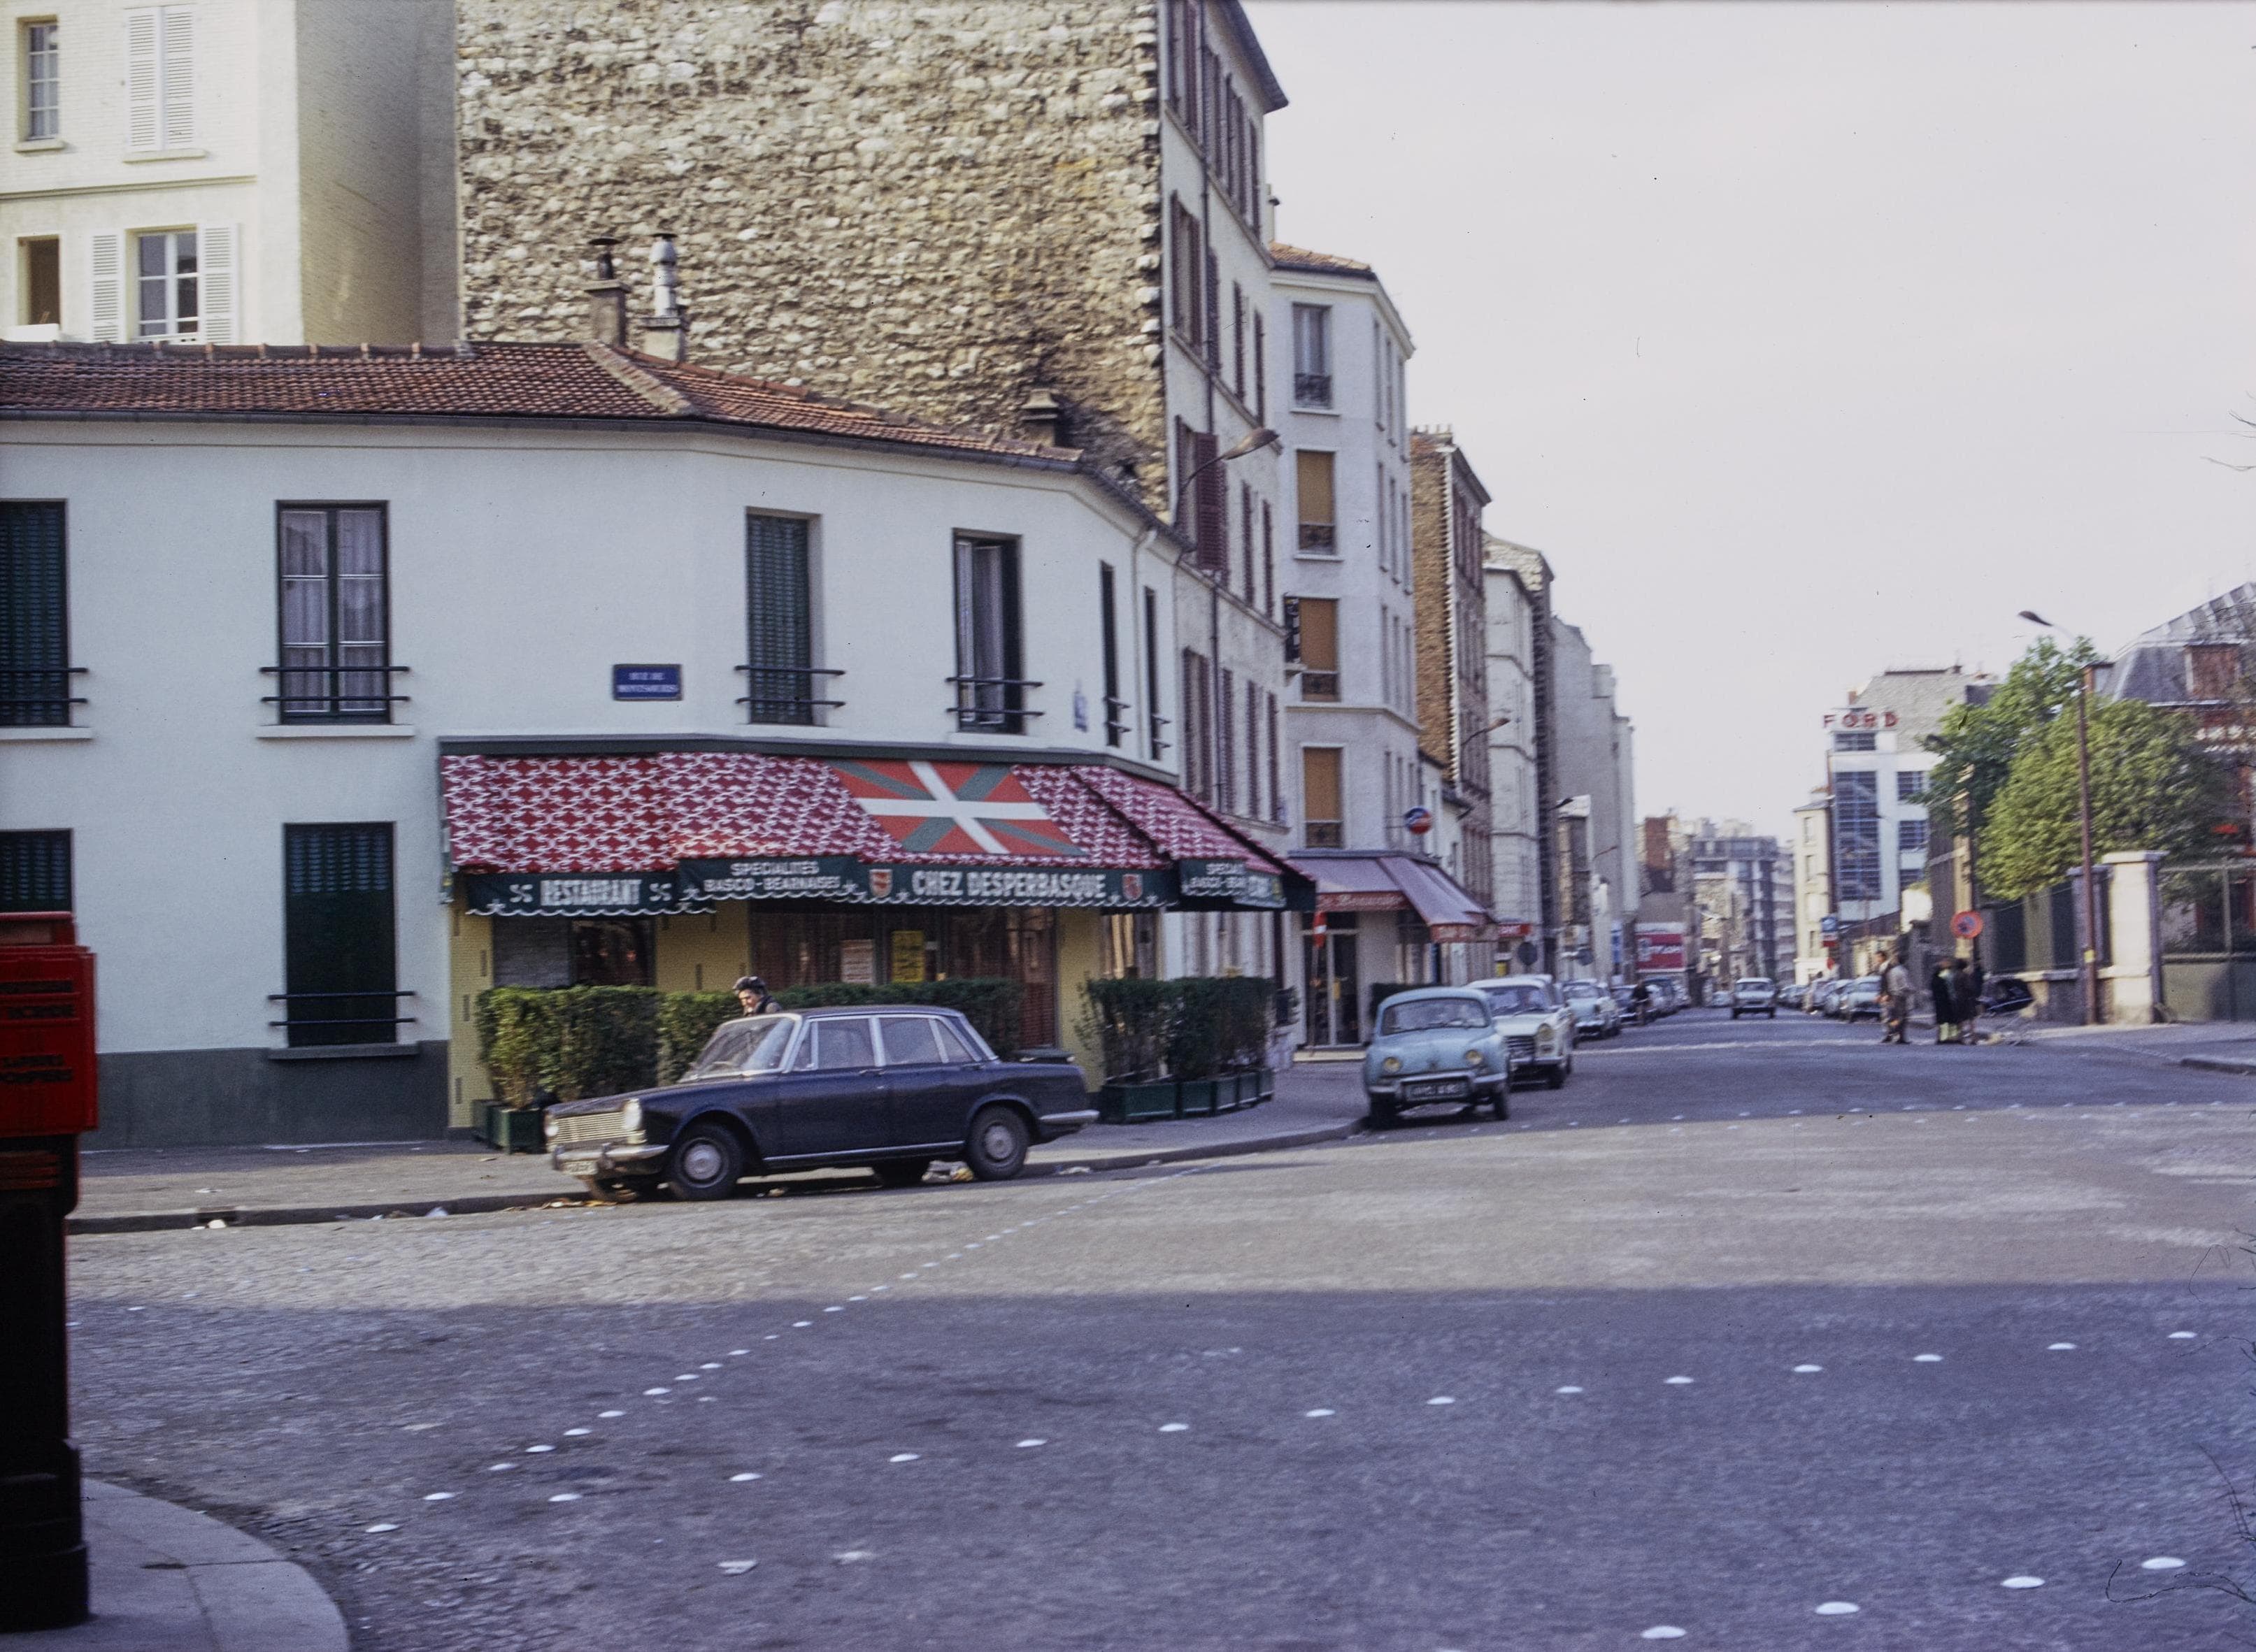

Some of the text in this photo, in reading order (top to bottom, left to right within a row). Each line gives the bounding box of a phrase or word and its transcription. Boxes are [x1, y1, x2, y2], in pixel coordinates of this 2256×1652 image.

[1822, 711, 1899, 728] FORD
[540, 879, 642, 906] RESTAURANT
[911, 870, 1106, 900] CHEZ DESPERBASQUE
